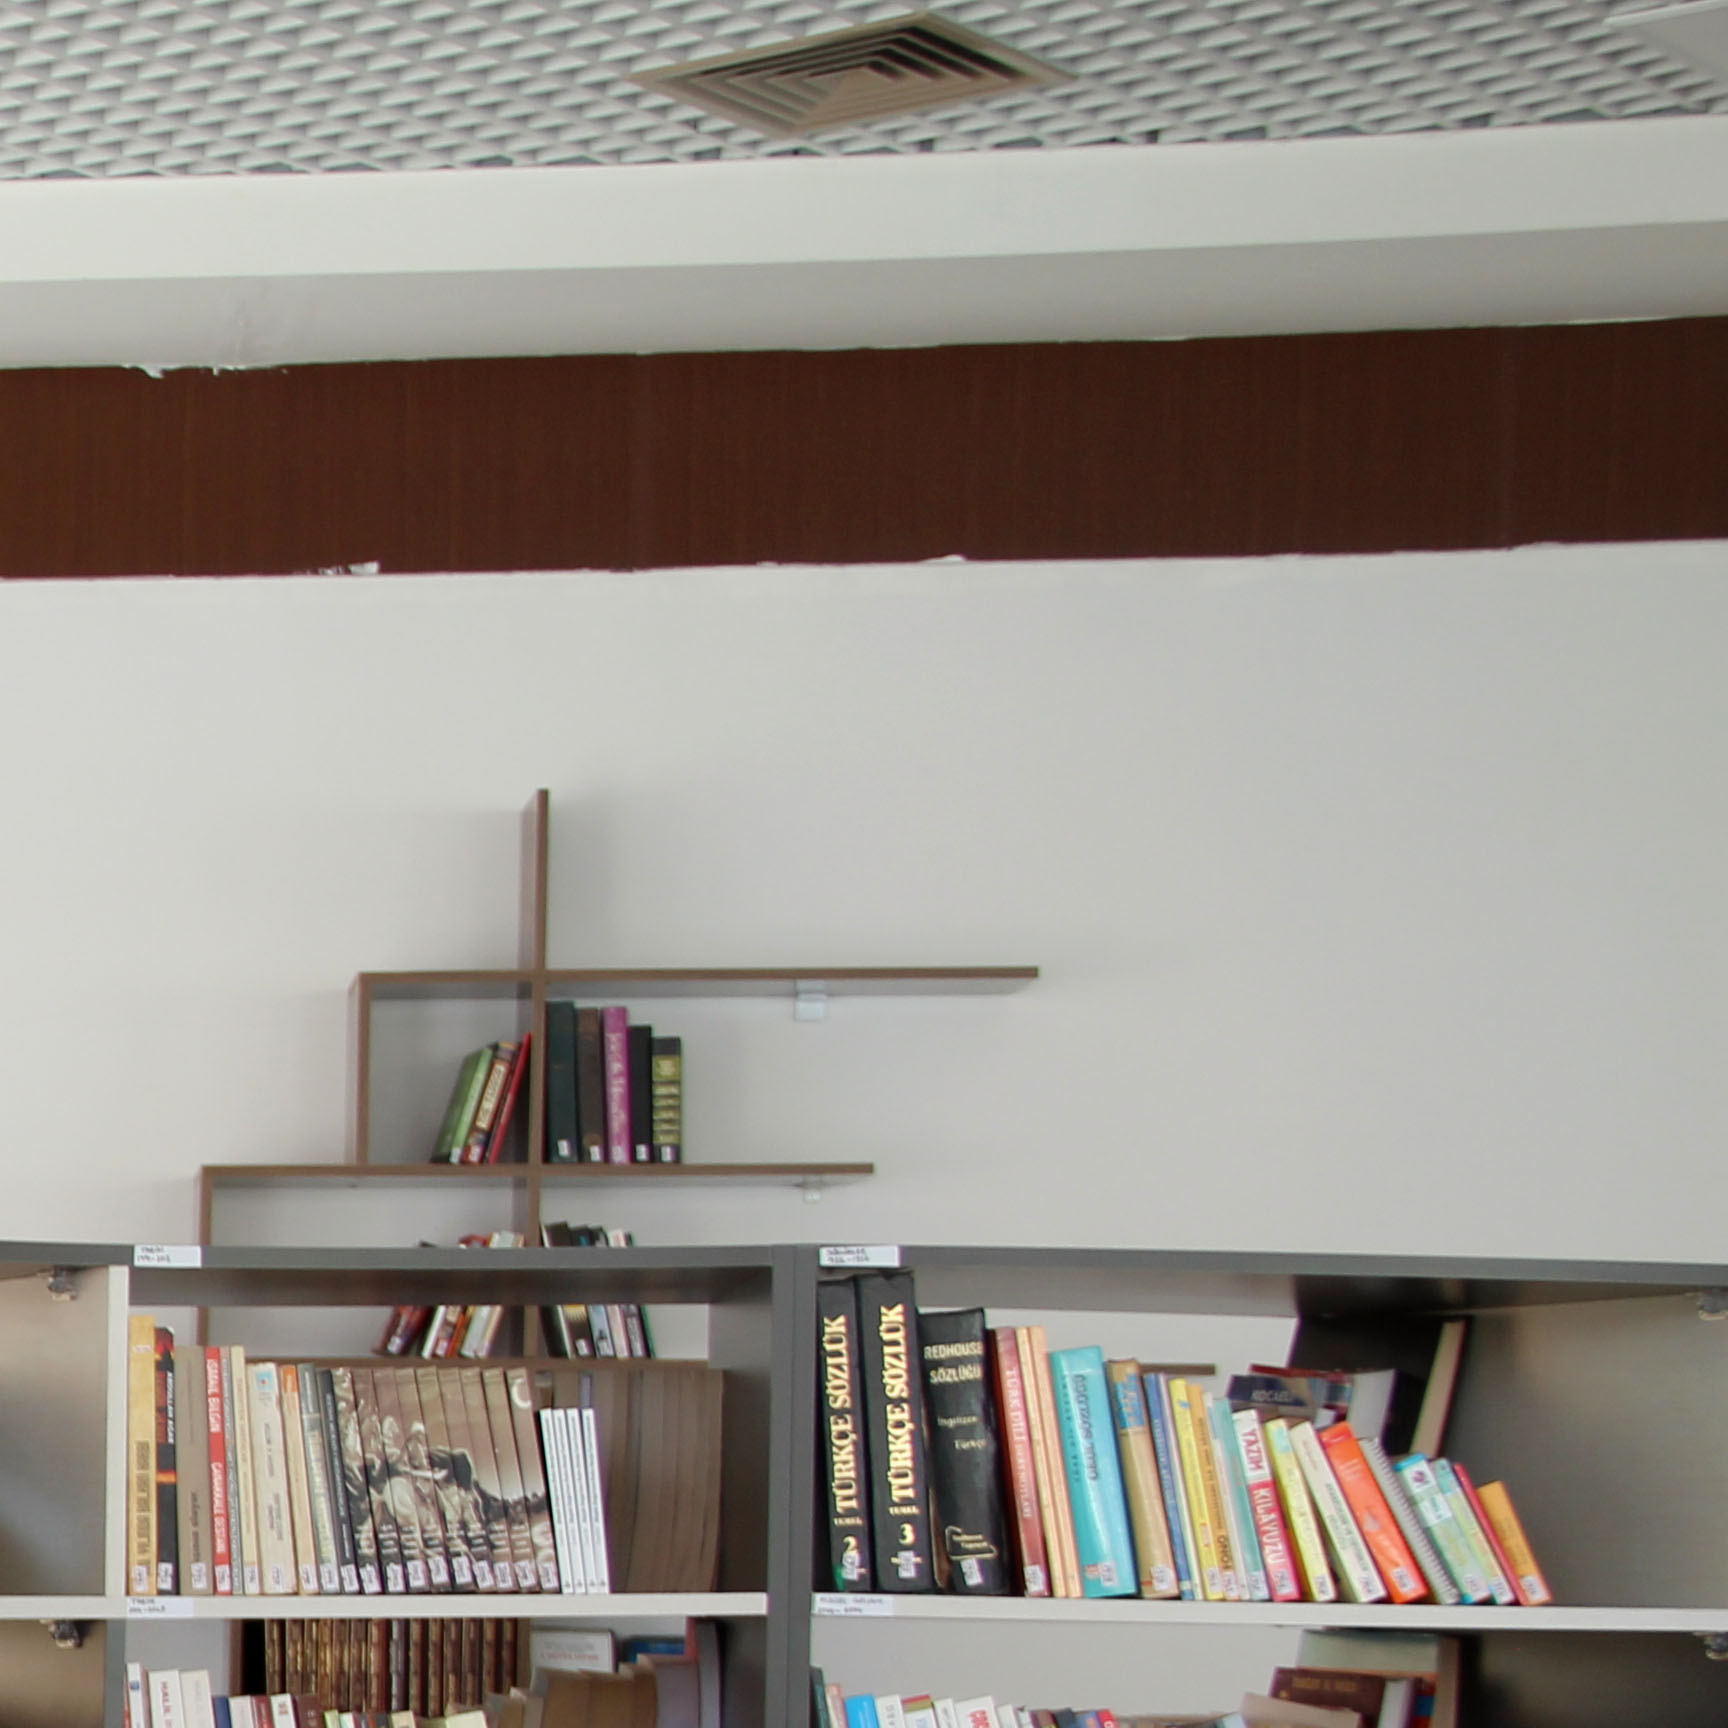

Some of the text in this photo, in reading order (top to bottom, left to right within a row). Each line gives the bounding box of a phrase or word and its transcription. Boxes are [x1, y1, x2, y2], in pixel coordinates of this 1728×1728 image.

[820, 1313, 861, 1515] TÜRKÇE SÖZLÜK
[877, 1303, 917, 1505] TÜRKÇE SÖZLÜK
[923, 1341, 985, 1360] REDHOUSE
[898, 1522, 916, 1546] 3
[1240, 1426, 1287, 1567] YAZIM KILAVUZU
